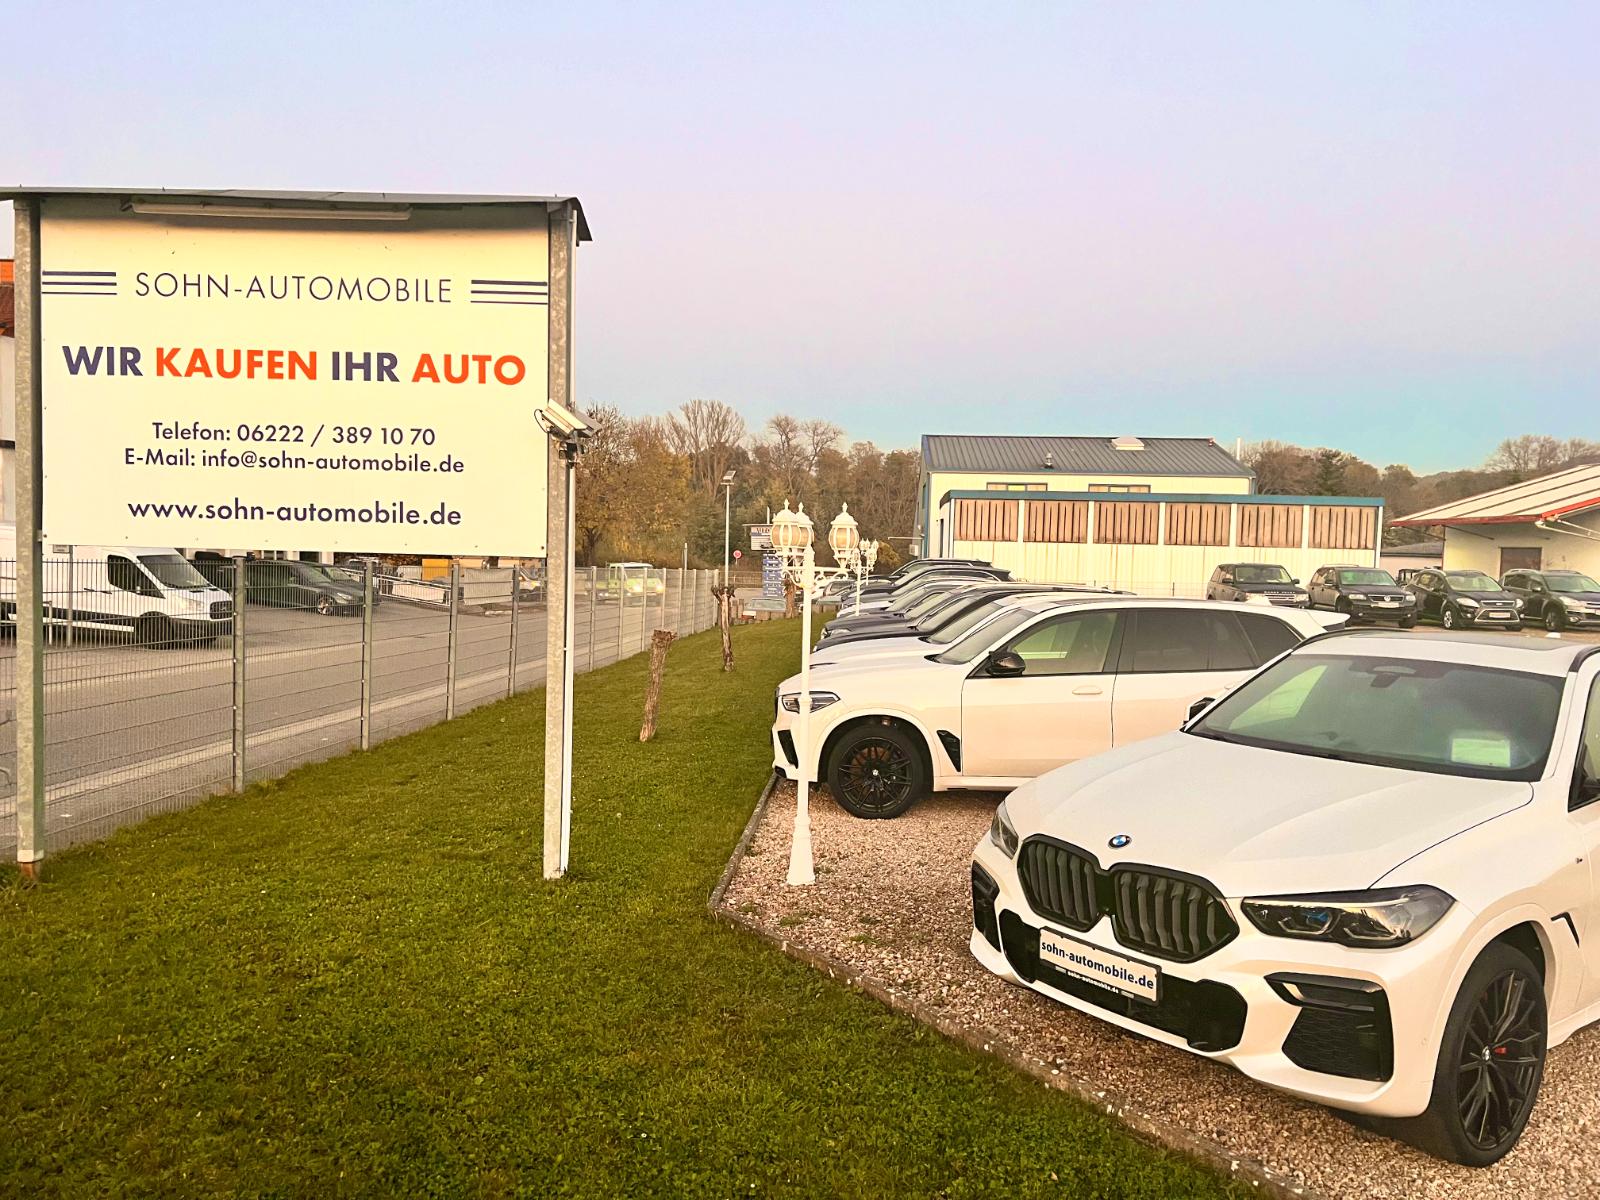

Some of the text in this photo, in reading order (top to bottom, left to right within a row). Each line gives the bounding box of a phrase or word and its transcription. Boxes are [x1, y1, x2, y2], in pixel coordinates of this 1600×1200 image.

[135, 272, 452, 304] SOHN-AUTOMOBILE
[62, 346, 526, 386] WIR KAUFEN IHR AUTO
[151, 421, 436, 448] Telefon: 06222 / 389 10 70
[125, 447, 465, 473] E-Mail: info@sohn-automobile.de
[127, 496, 462, 526] www.sohn-automobile.de
[1041, 941, 1154, 990] sohn-automobile.de
